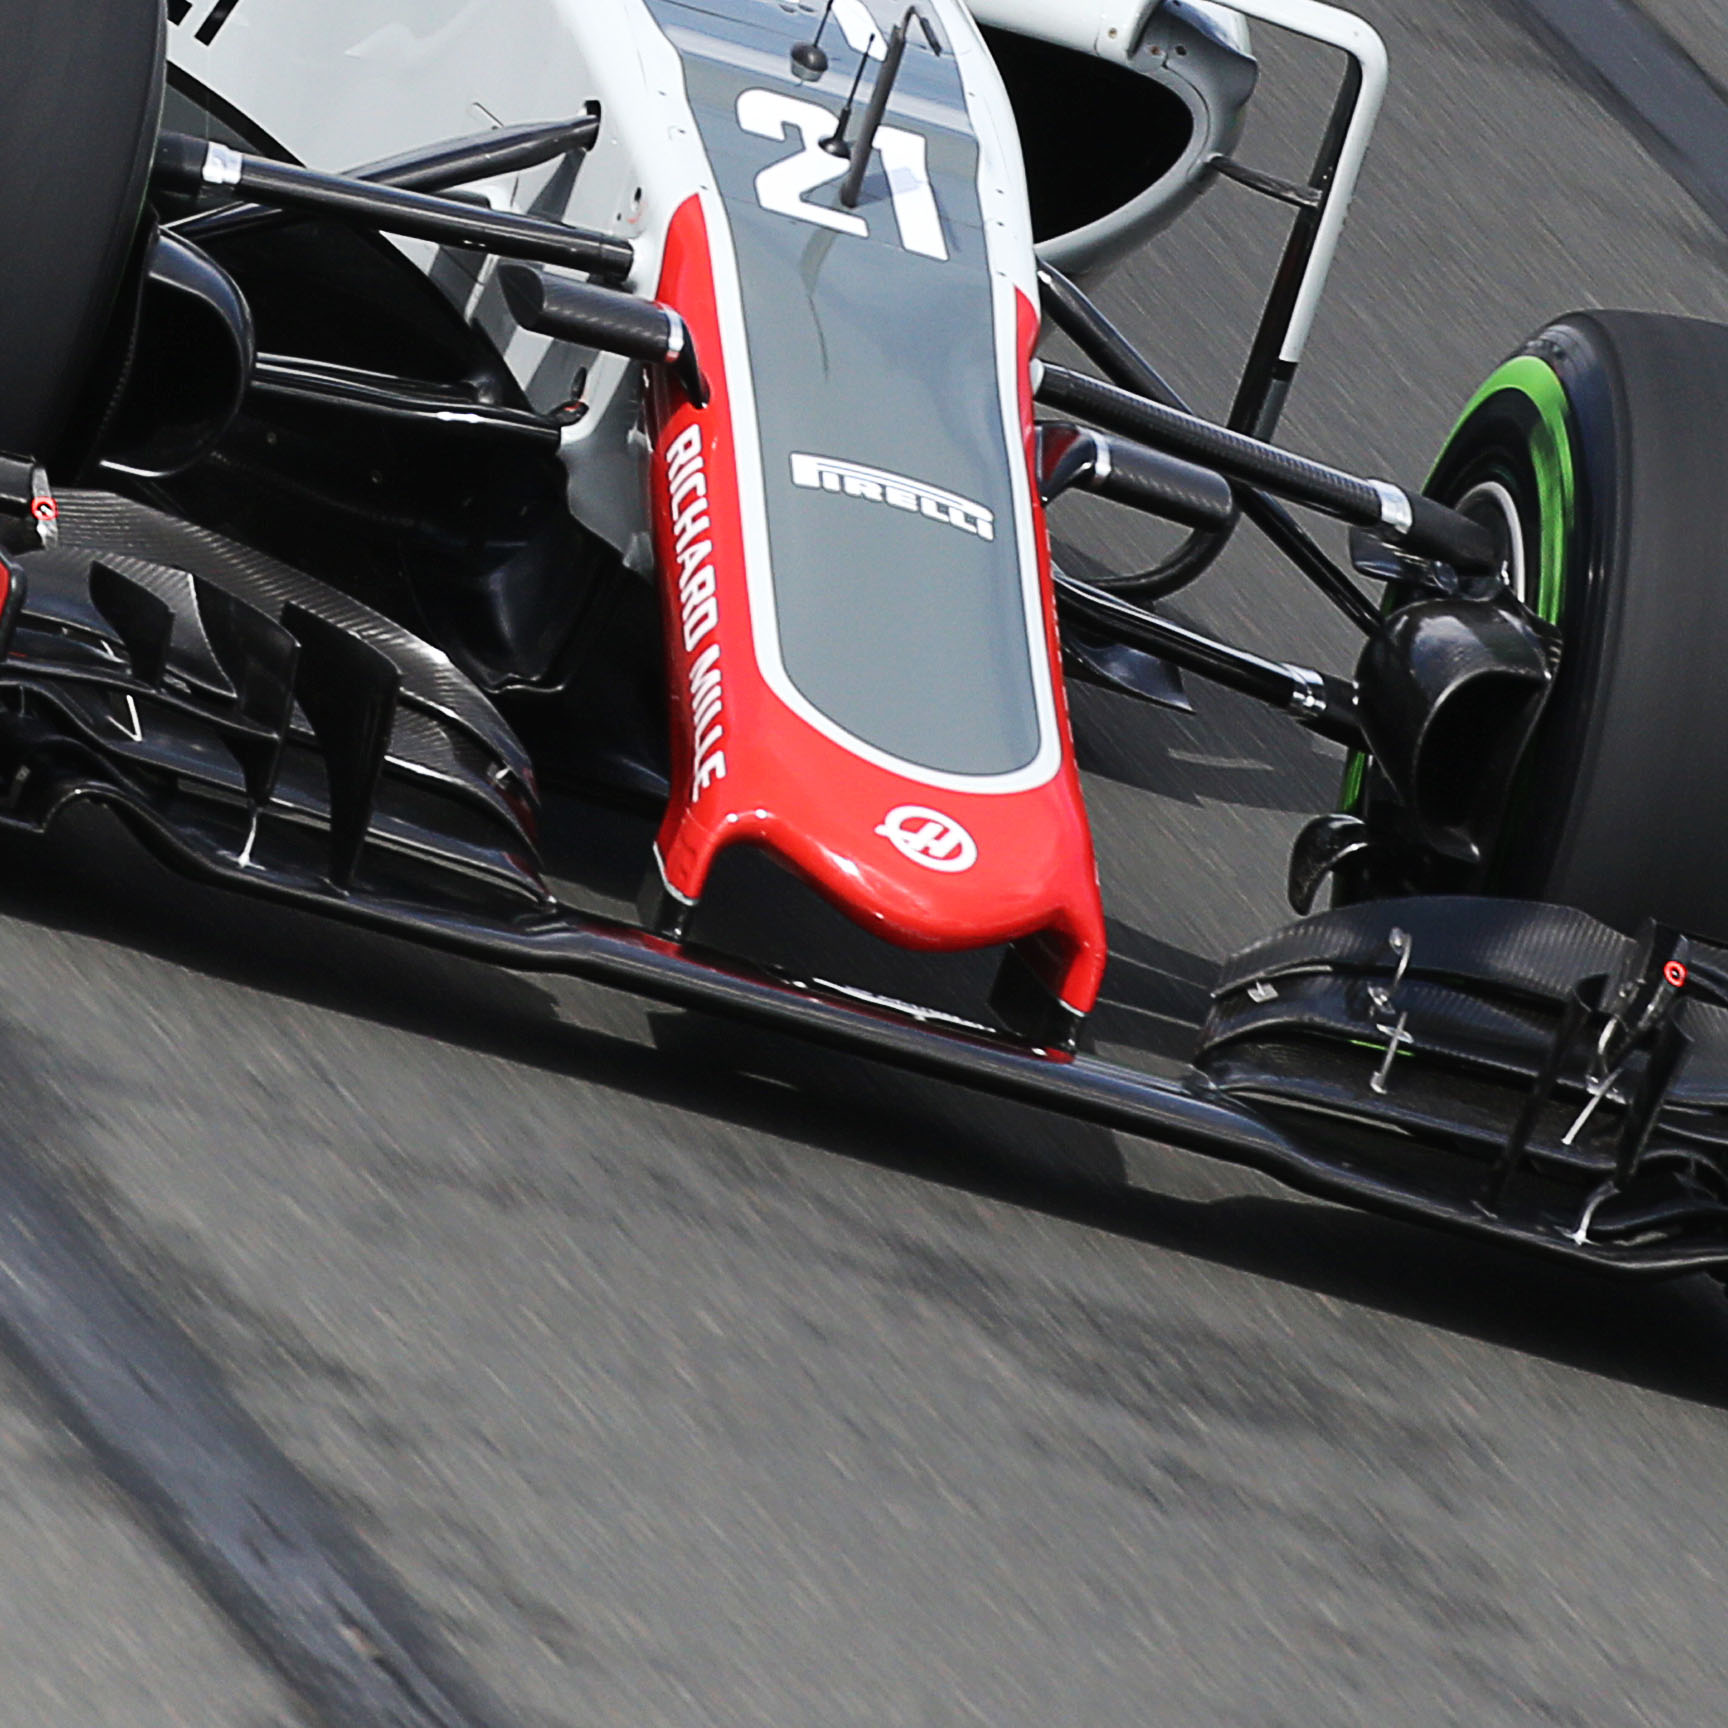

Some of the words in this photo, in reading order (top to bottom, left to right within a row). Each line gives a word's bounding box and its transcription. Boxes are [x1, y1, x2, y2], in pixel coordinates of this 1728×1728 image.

[735, 87, 949, 261] 21
[665, 423, 719, 652] RICHARD
[790, 452, 995, 541] PIRELLI
[688, 643, 727, 804] MILLE
